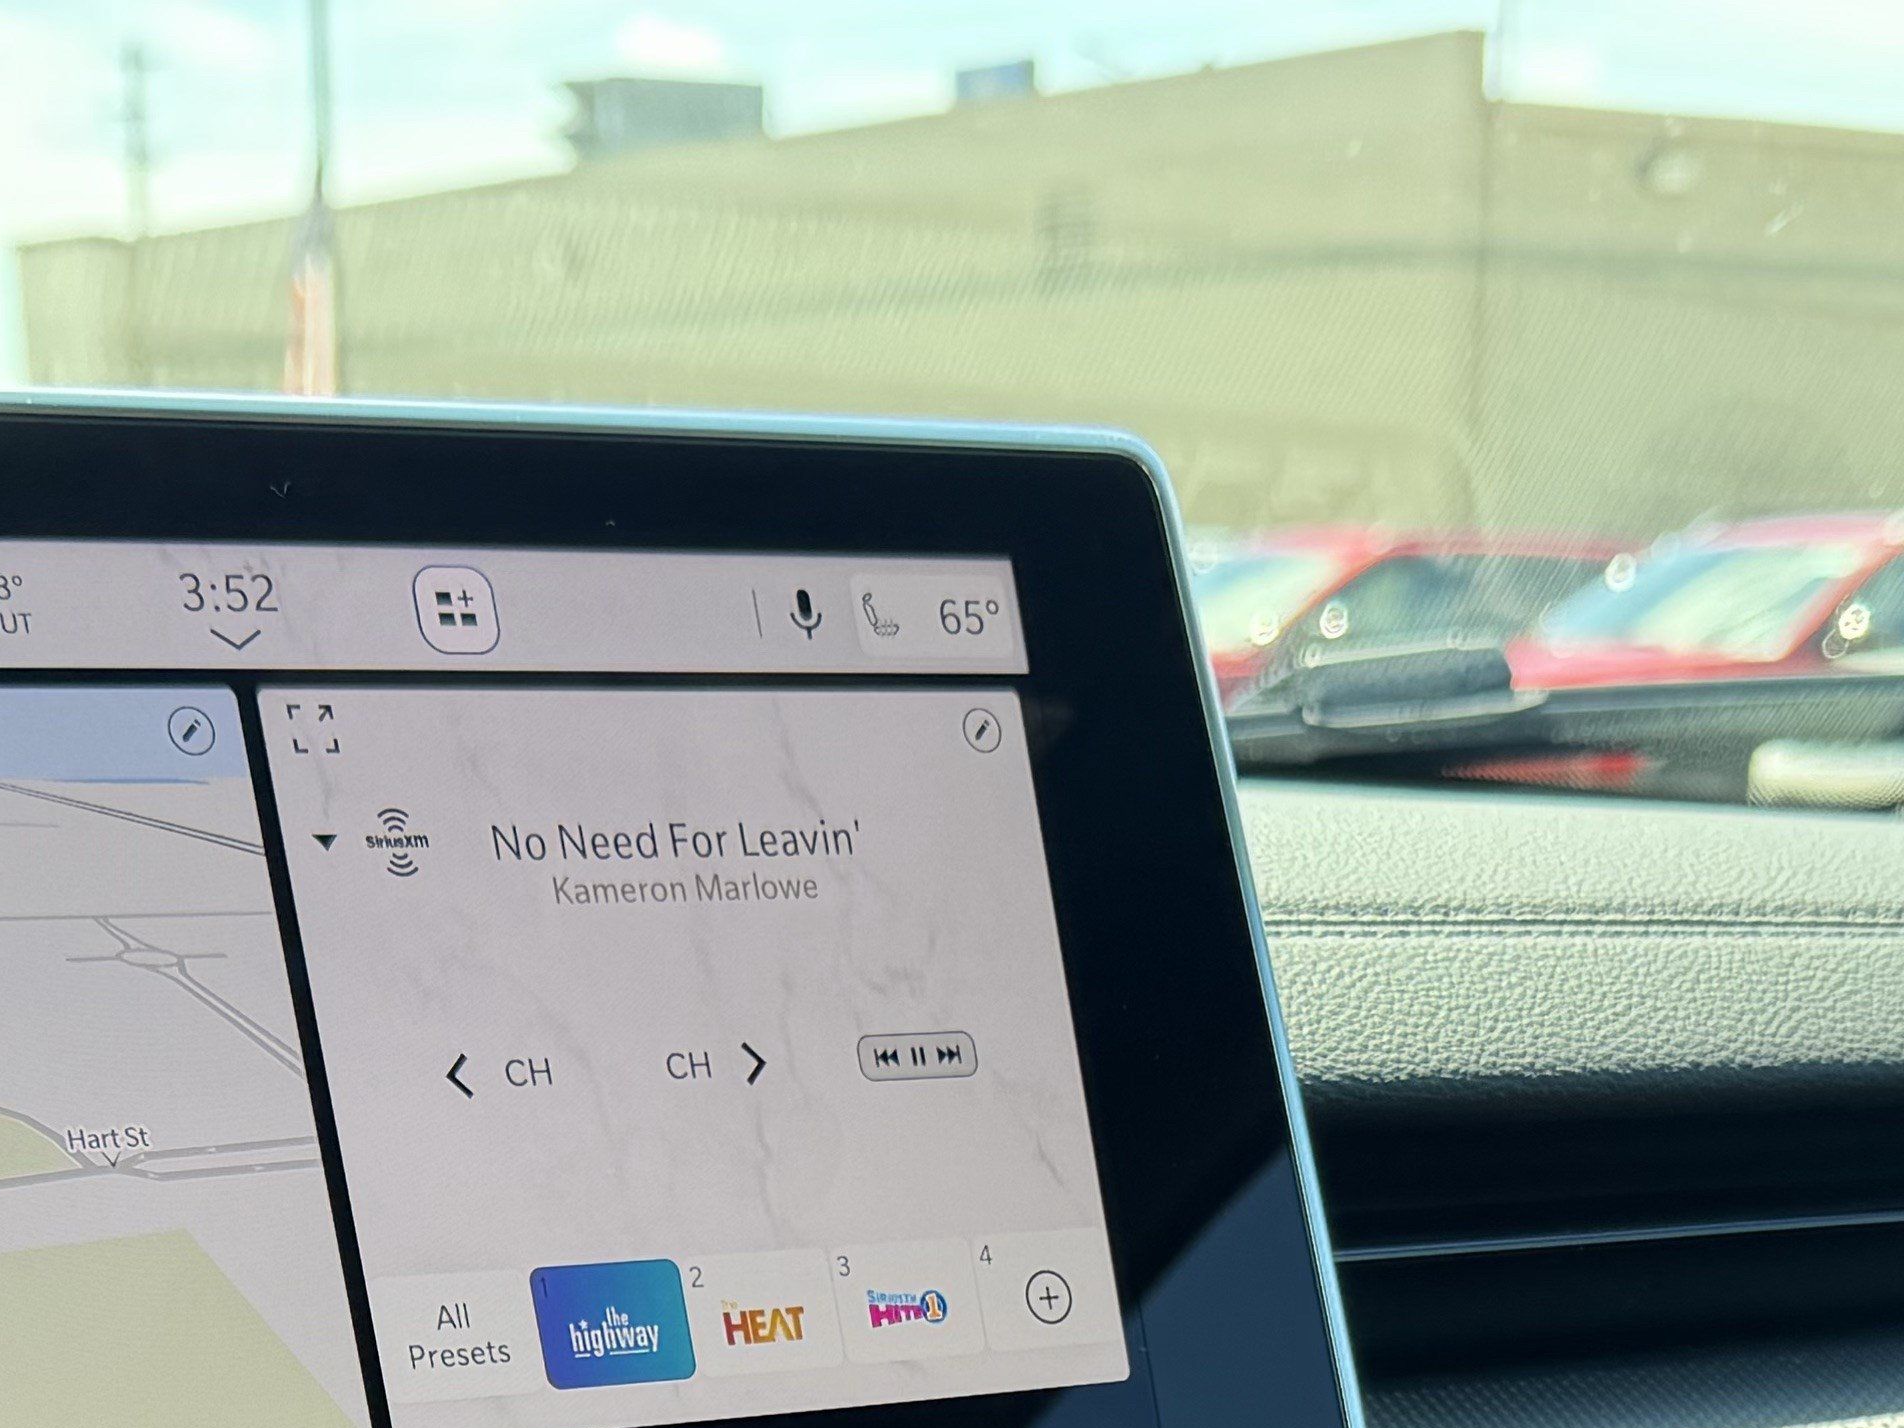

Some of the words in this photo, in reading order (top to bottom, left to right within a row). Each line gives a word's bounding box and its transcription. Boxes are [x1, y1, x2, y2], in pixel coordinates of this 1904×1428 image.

[179, 574, 279, 614] 3:52
[939, 599, 1000, 635] 65°
[492, 824, 547, 861] No
[558, 822, 659, 860] Need
[670, 822, 728, 858] For
[741, 820, 860, 857] Leavin'
[553, 877, 688, 905] Kameron
[695, 873, 819, 903] Marlowe
[505, 1058, 552, 1087] CH
[666, 1051, 711, 1080] CH
[67, 1129, 120, 1150] Hart
[125, 1127, 149, 1149] St
[837, 1256, 850, 1277] 3
[980, 1245, 992, 1265] 4
[690, 1266, 704, 1288] 2
[437, 1302, 471, 1331] All
[606, 1306, 629, 1327] the
[723, 1306, 804, 1345] HEAT
[569, 1321, 659, 1358] highway
[408, 1341, 511, 1370] Presets
